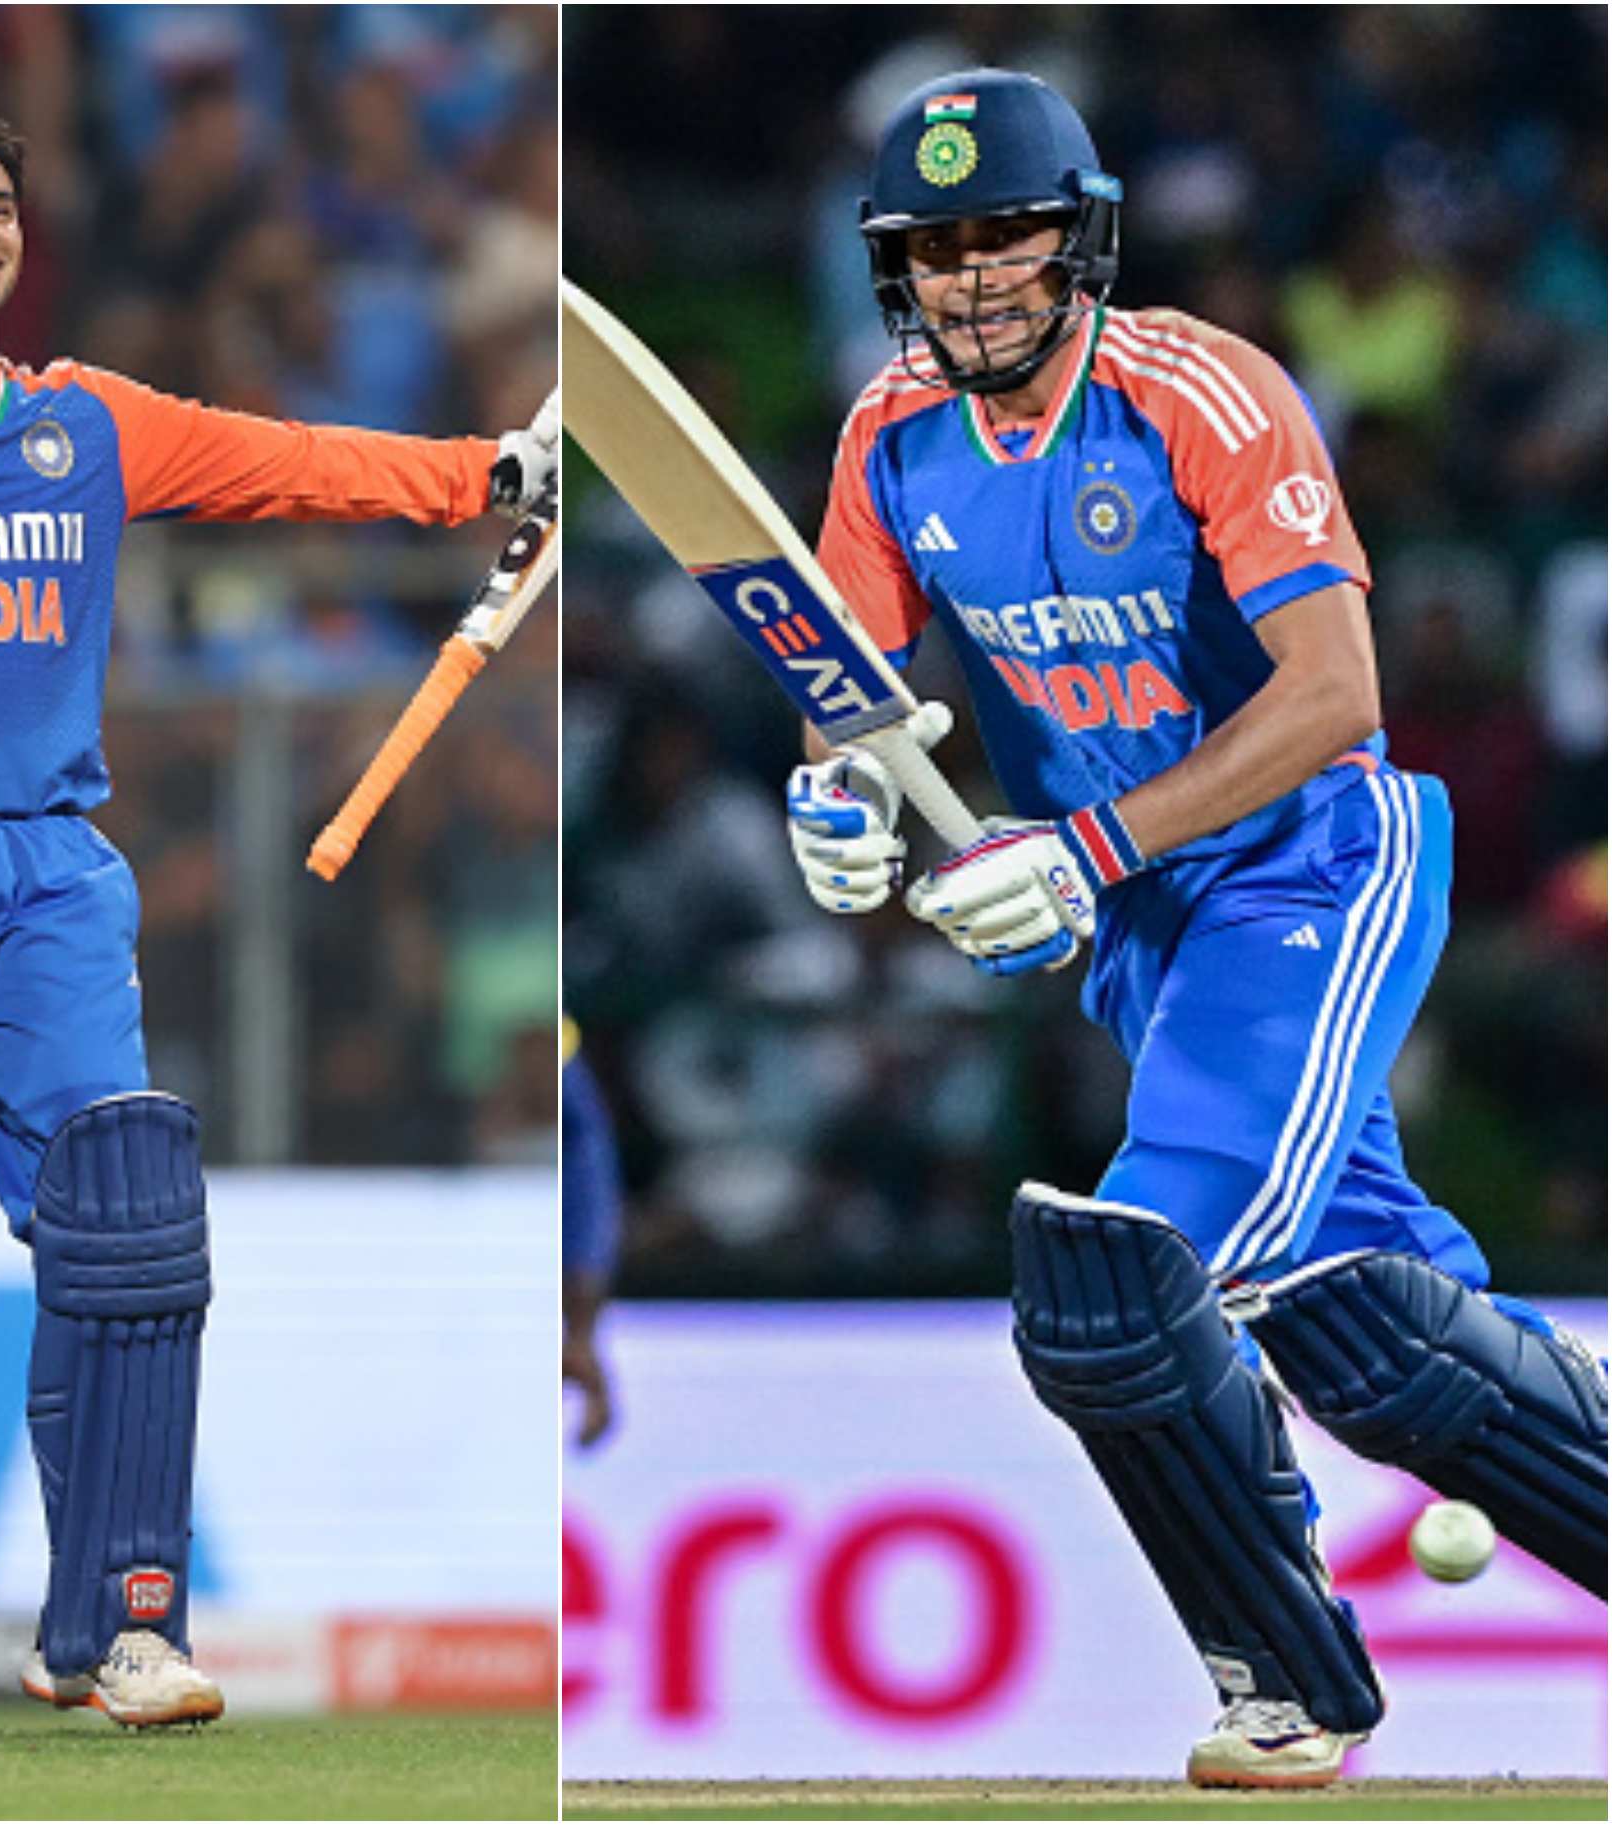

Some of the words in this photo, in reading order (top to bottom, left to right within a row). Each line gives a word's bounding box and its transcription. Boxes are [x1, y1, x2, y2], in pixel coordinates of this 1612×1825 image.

[735, 576, 875, 714] CEAT
[950, 588, 1175, 655] REAM11
[562, 1503, 1031, 1722] ro
